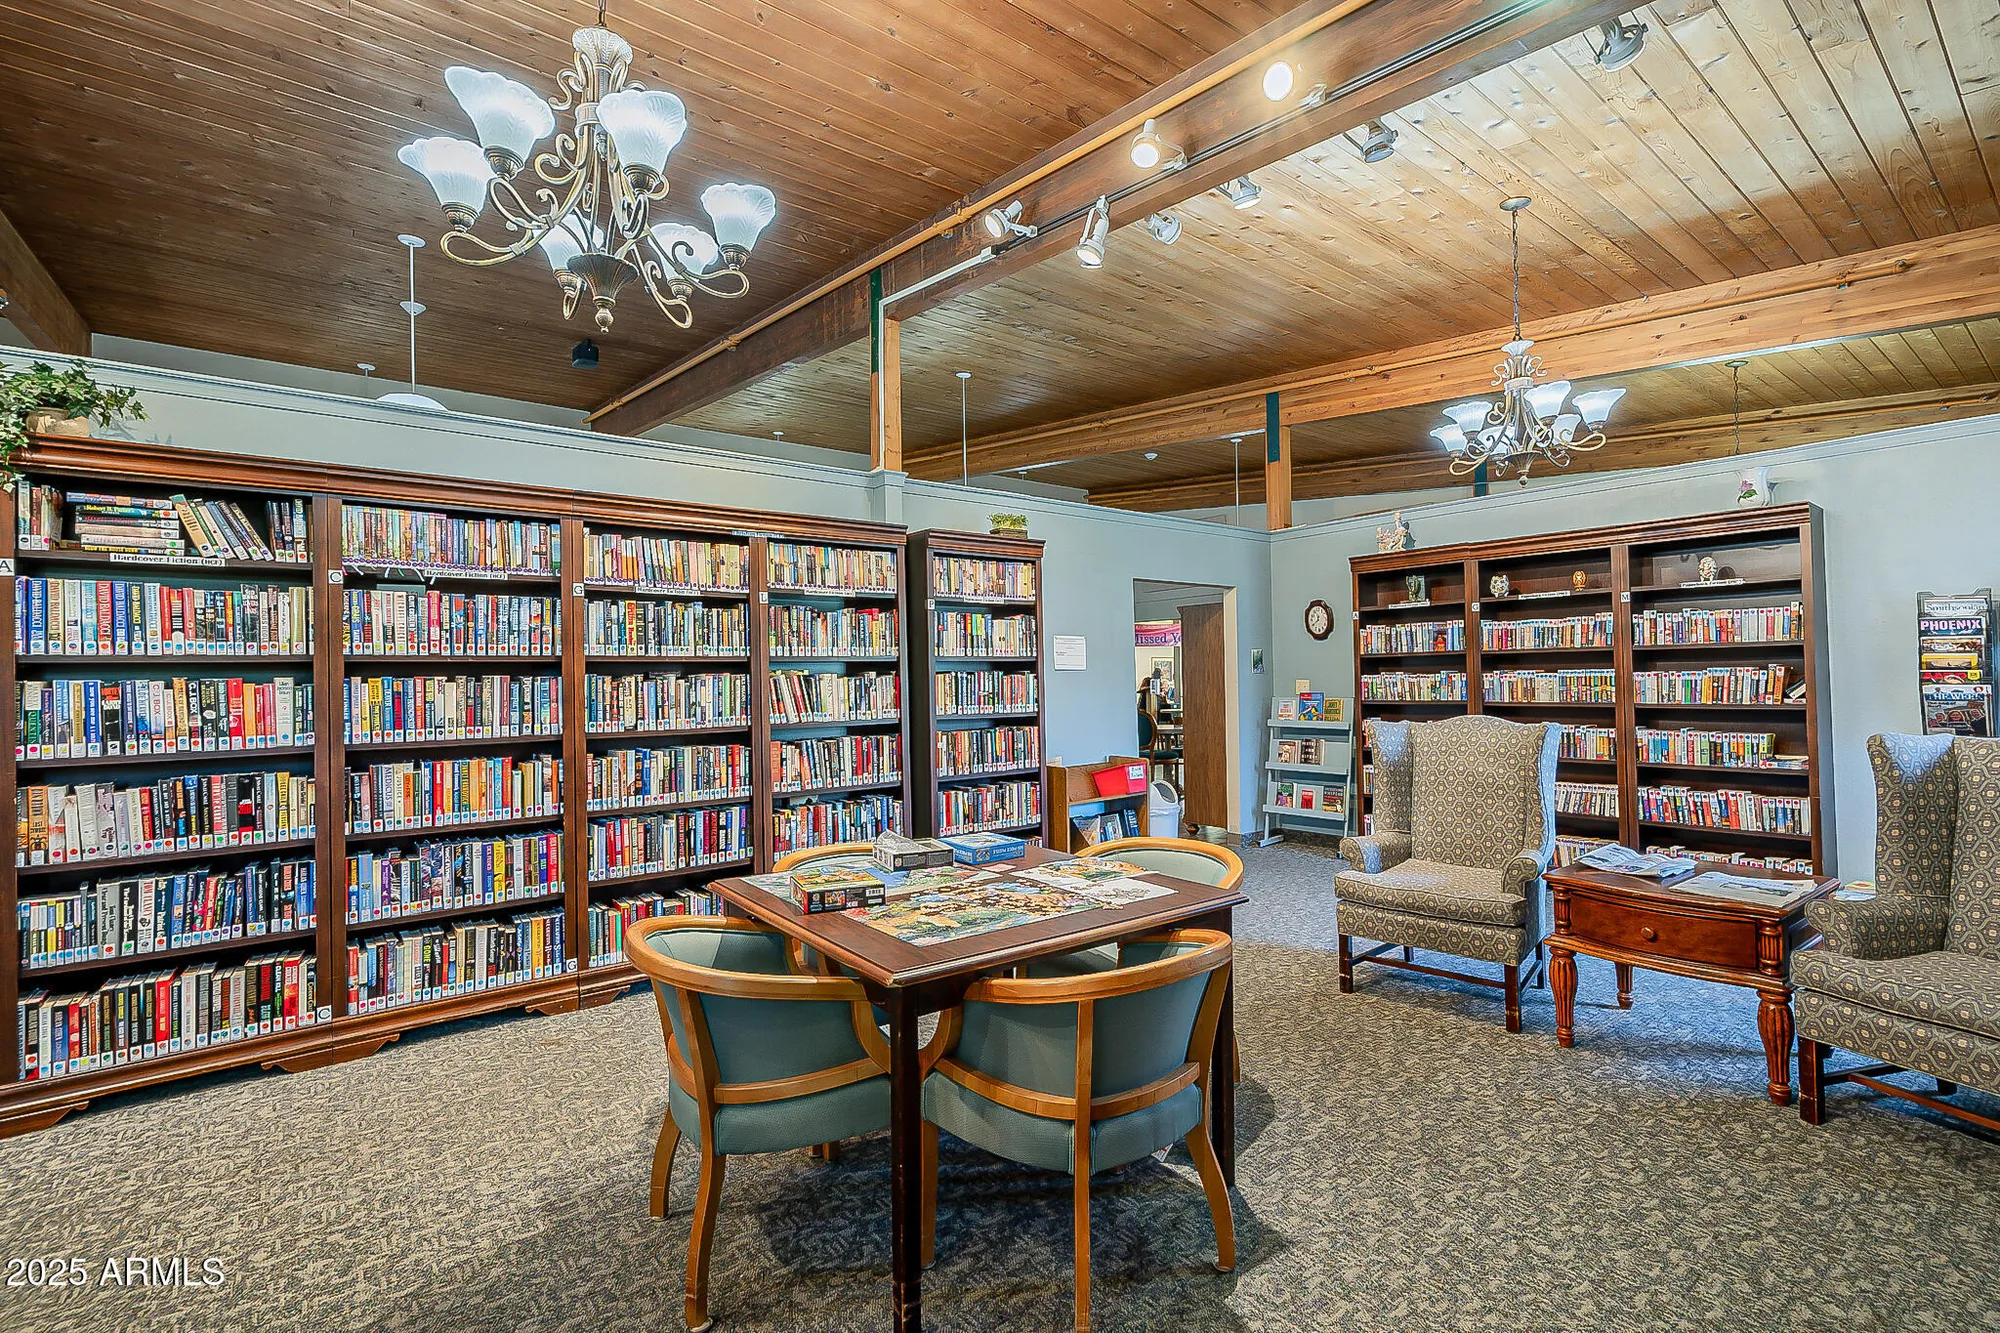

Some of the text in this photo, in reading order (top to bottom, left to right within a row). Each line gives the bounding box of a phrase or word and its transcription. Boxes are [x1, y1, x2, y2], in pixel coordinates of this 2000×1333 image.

[113, 554, 163, 562] Hardcover
[0, 560, 12, 572] A
[330, 571, 342, 582] C
[574, 586, 583, 595] G
[99, 583, 111, 634] DAVID BALDACCI
[929, 600, 935, 608] P
[1926, 603, 1985, 612] Smithsonian
[1920, 619, 1981, 631] PHOENIX
[384, 767, 392, 801] MEDICUS
[144, 881, 154, 893] TOM
[423, 945, 431, 963] GONE
[567, 960, 577, 970] G
[318, 1007, 330, 1020] C
